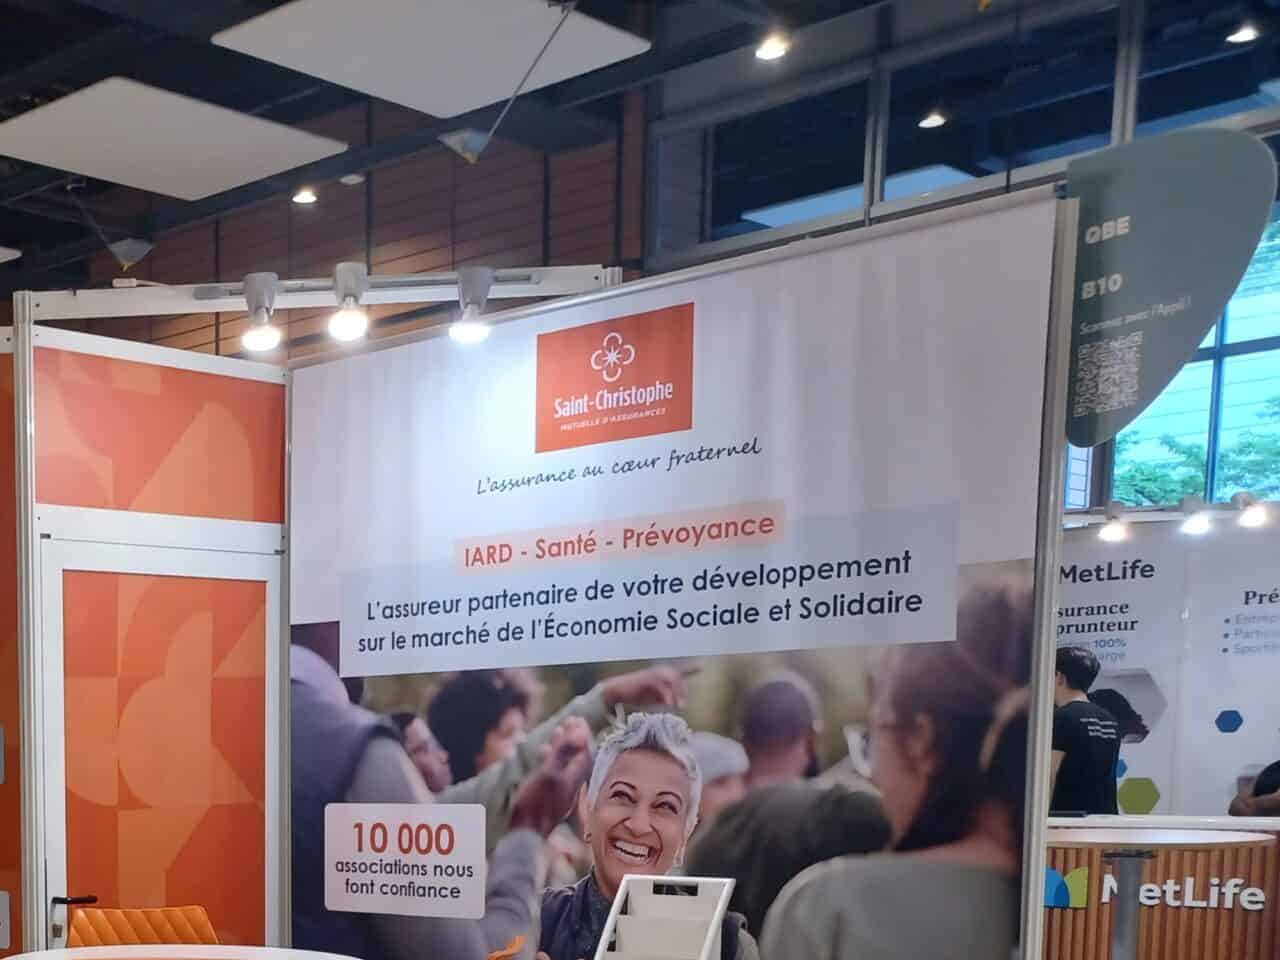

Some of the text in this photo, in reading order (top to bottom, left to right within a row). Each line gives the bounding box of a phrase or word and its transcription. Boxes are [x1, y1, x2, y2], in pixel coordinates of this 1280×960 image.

[1085, 216, 1131, 244] QBE
[1081, 274, 1124, 300] B10
[553, 380, 674, 419] Saint-Christophe
[560, 407, 667, 432] MUTUELLE D'ASSURANCES
[477, 436, 762, 495] L'assurance au cœur fraternel
[464, 543, 513, 568] IARD
[535, 530, 597, 560] Santé
[623, 517, 775, 549] Prévoyance
[1059, 559, 1155, 584] MetLife
[367, 549, 913, 621] L'assureur partenaire de votre développement
[1244, 587, 1280, 605] Pré
[358, 590, 924, 653] sur le marché de l'Économie Sociale et Solidaire
[1057, 602, 1129, 618] surance
[1056, 619, 1139, 638] prunteur
[353, 822, 455, 855] 10 000
[335, 859, 473, 878] associations nous
[345, 878, 461, 898] font confiance
